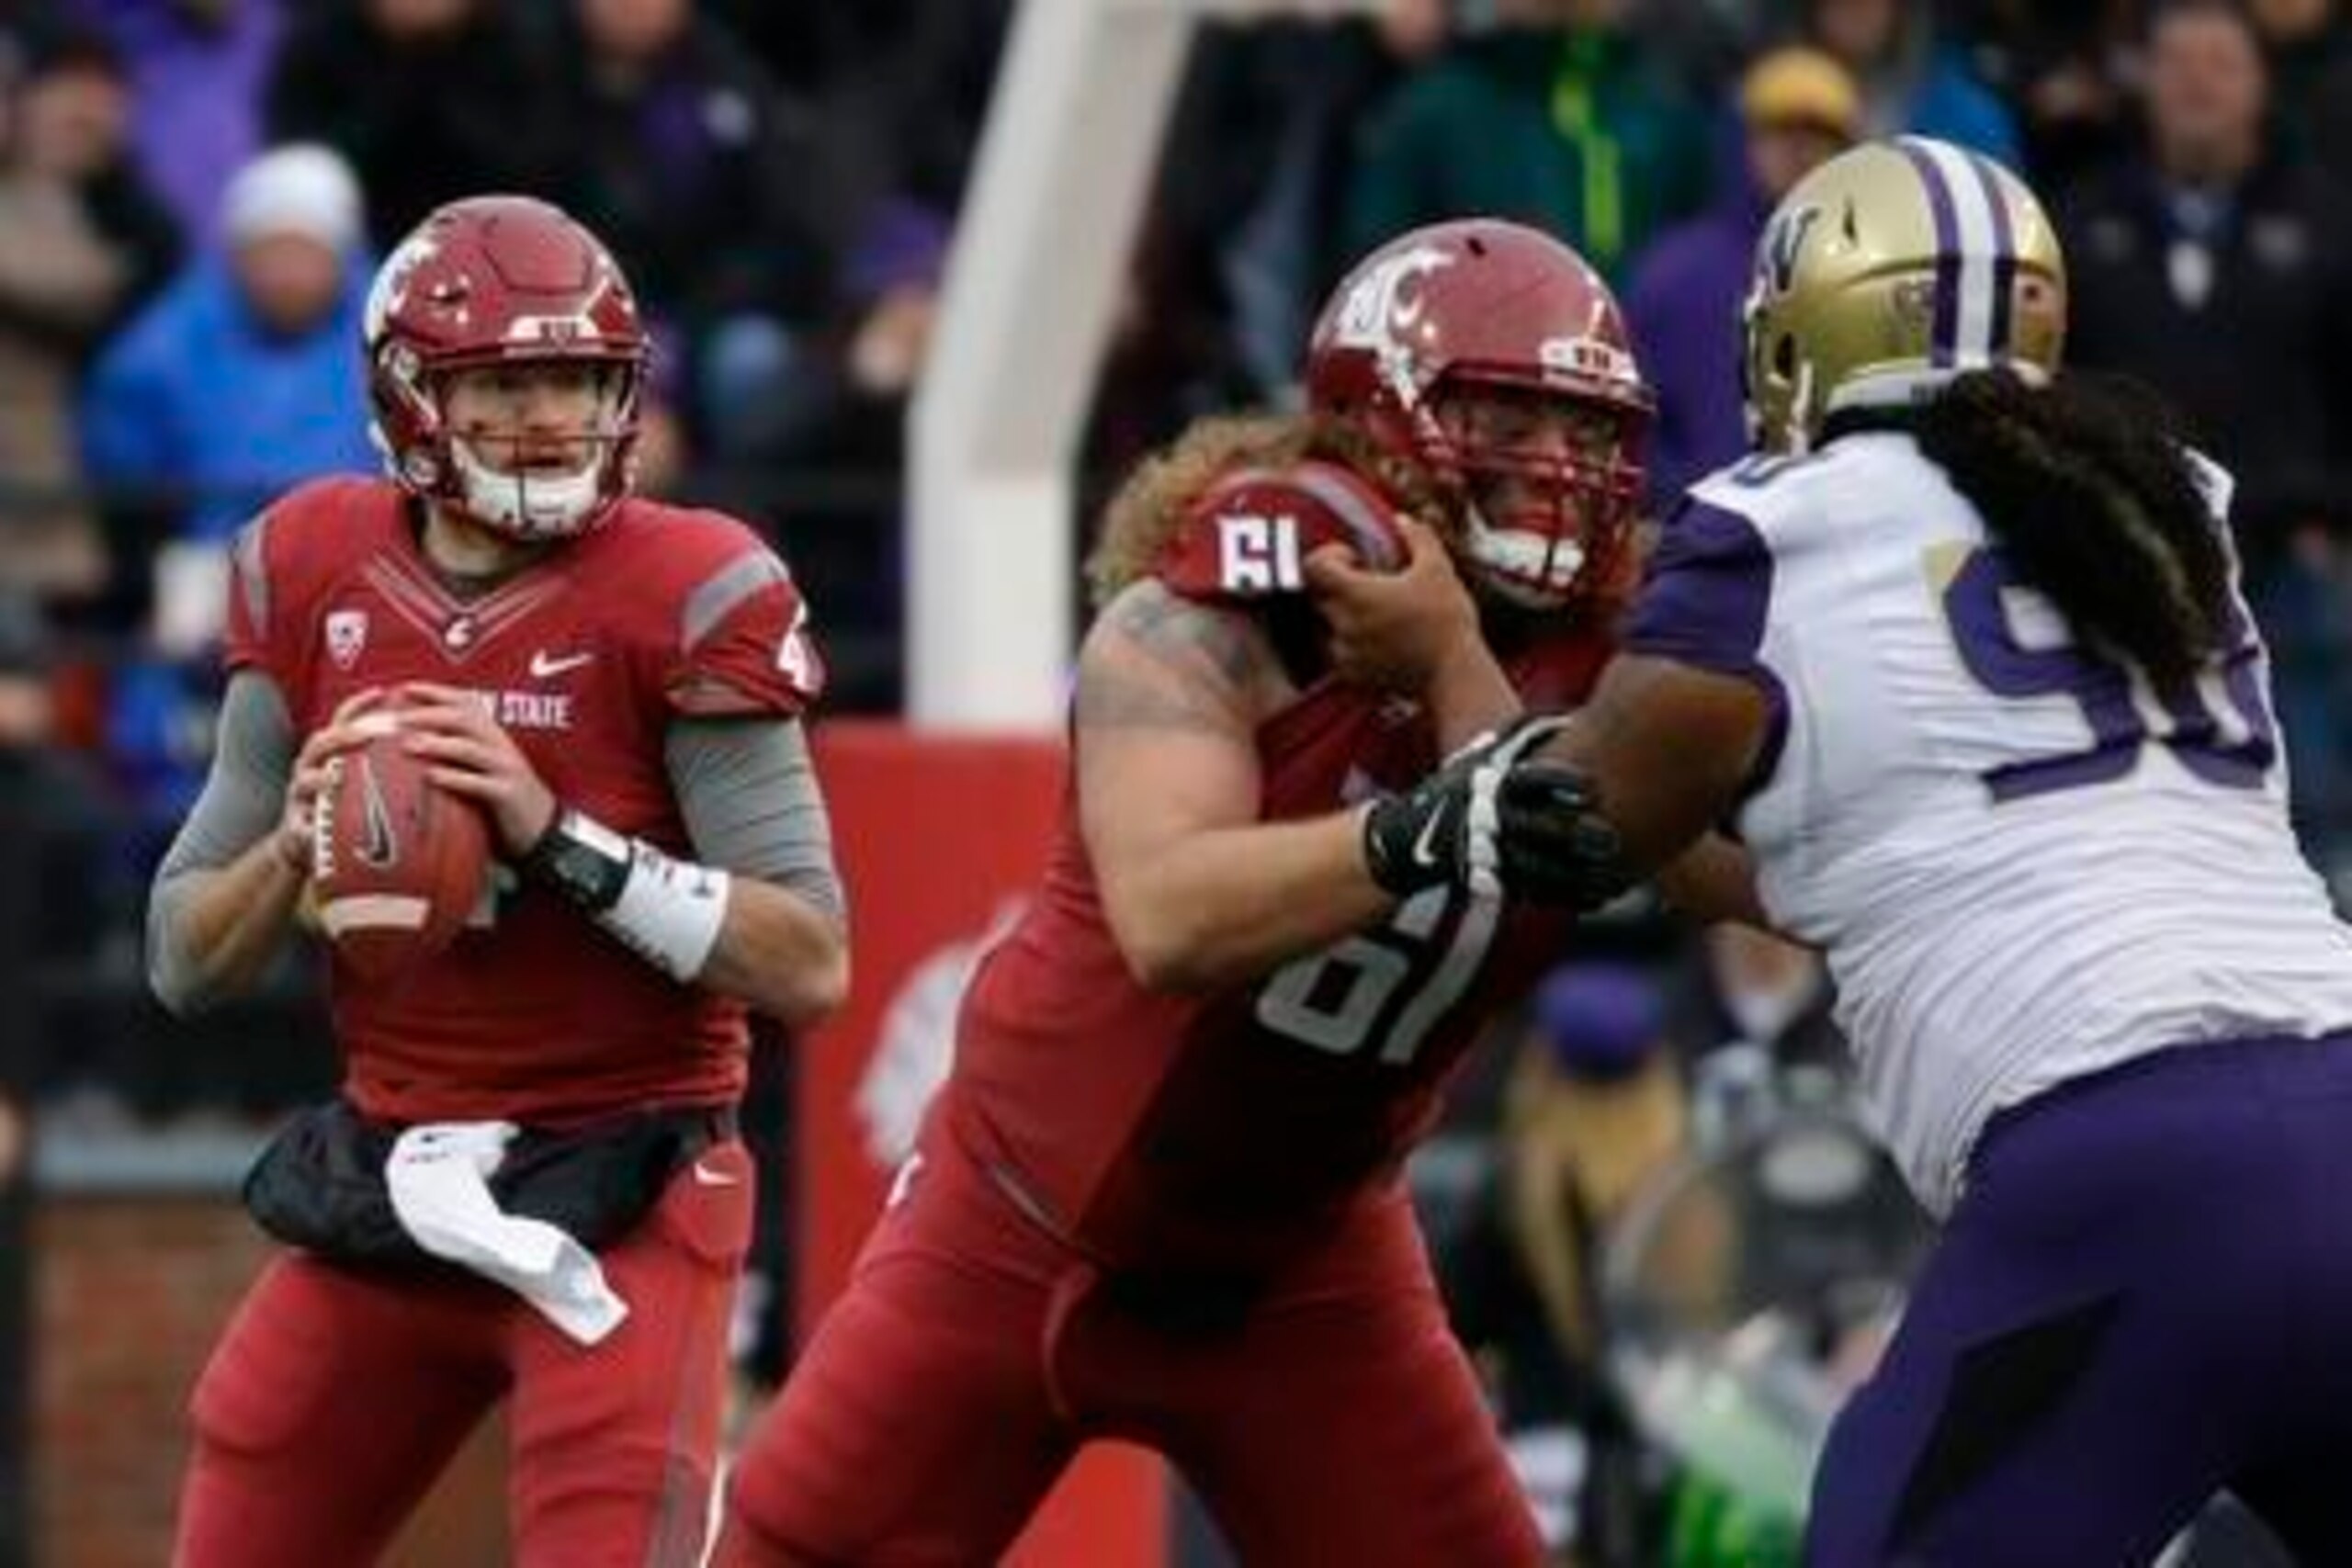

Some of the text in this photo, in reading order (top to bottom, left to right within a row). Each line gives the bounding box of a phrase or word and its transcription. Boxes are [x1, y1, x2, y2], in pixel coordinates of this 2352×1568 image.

[1217, 514, 1302, 591] 61
[502, 691, 572, 728] STATE
[1255, 880, 1503, 1066] 61
